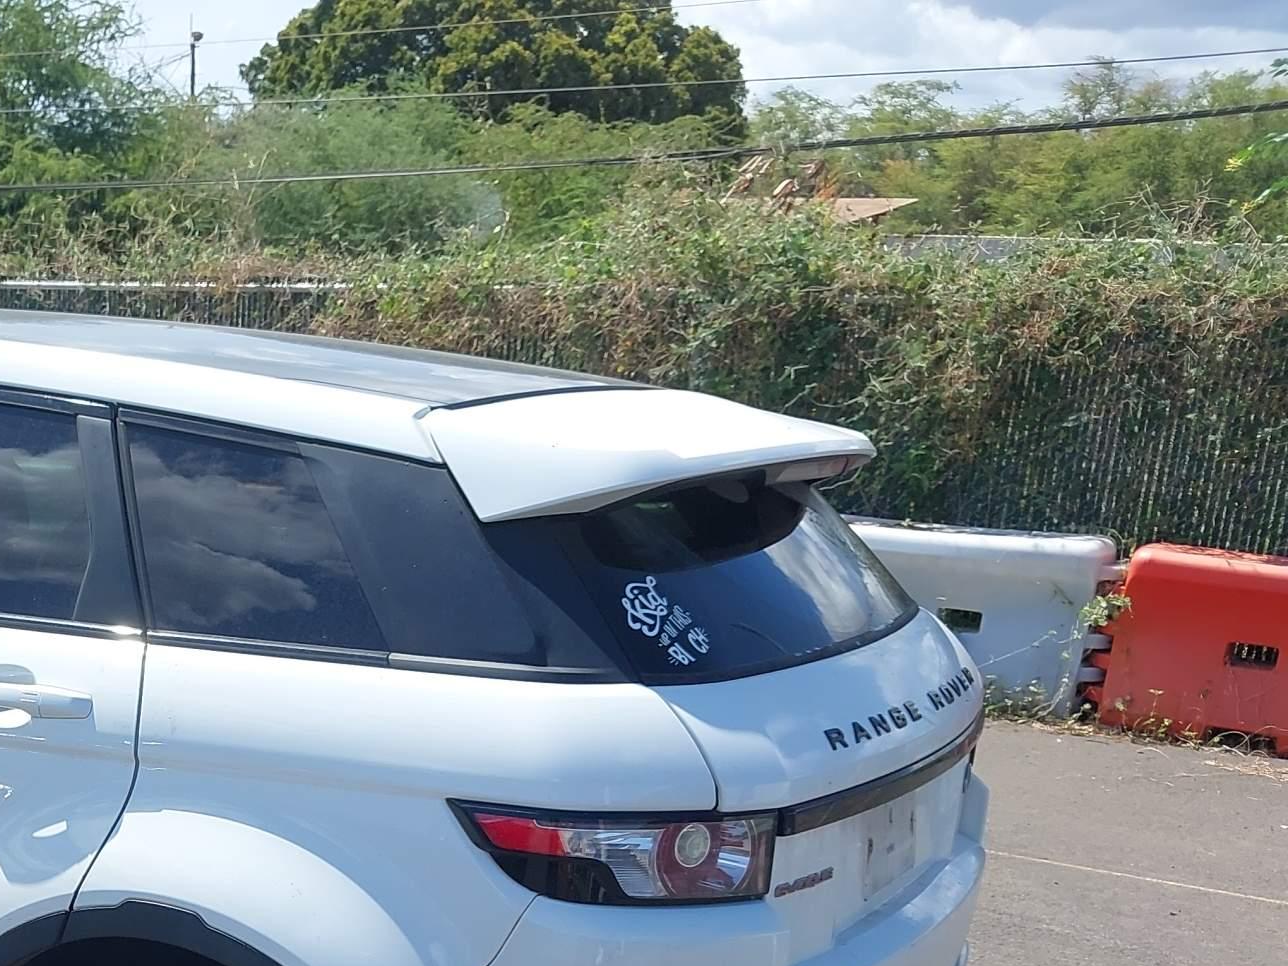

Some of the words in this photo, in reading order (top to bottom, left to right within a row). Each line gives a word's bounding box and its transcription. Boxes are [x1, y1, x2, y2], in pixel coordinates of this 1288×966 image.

[621, 575, 669, 637] Kid
[668, 605, 692, 631] THIS
[823, 699, 922, 751] RANGE
[926, 666, 975, 711] ROVER
